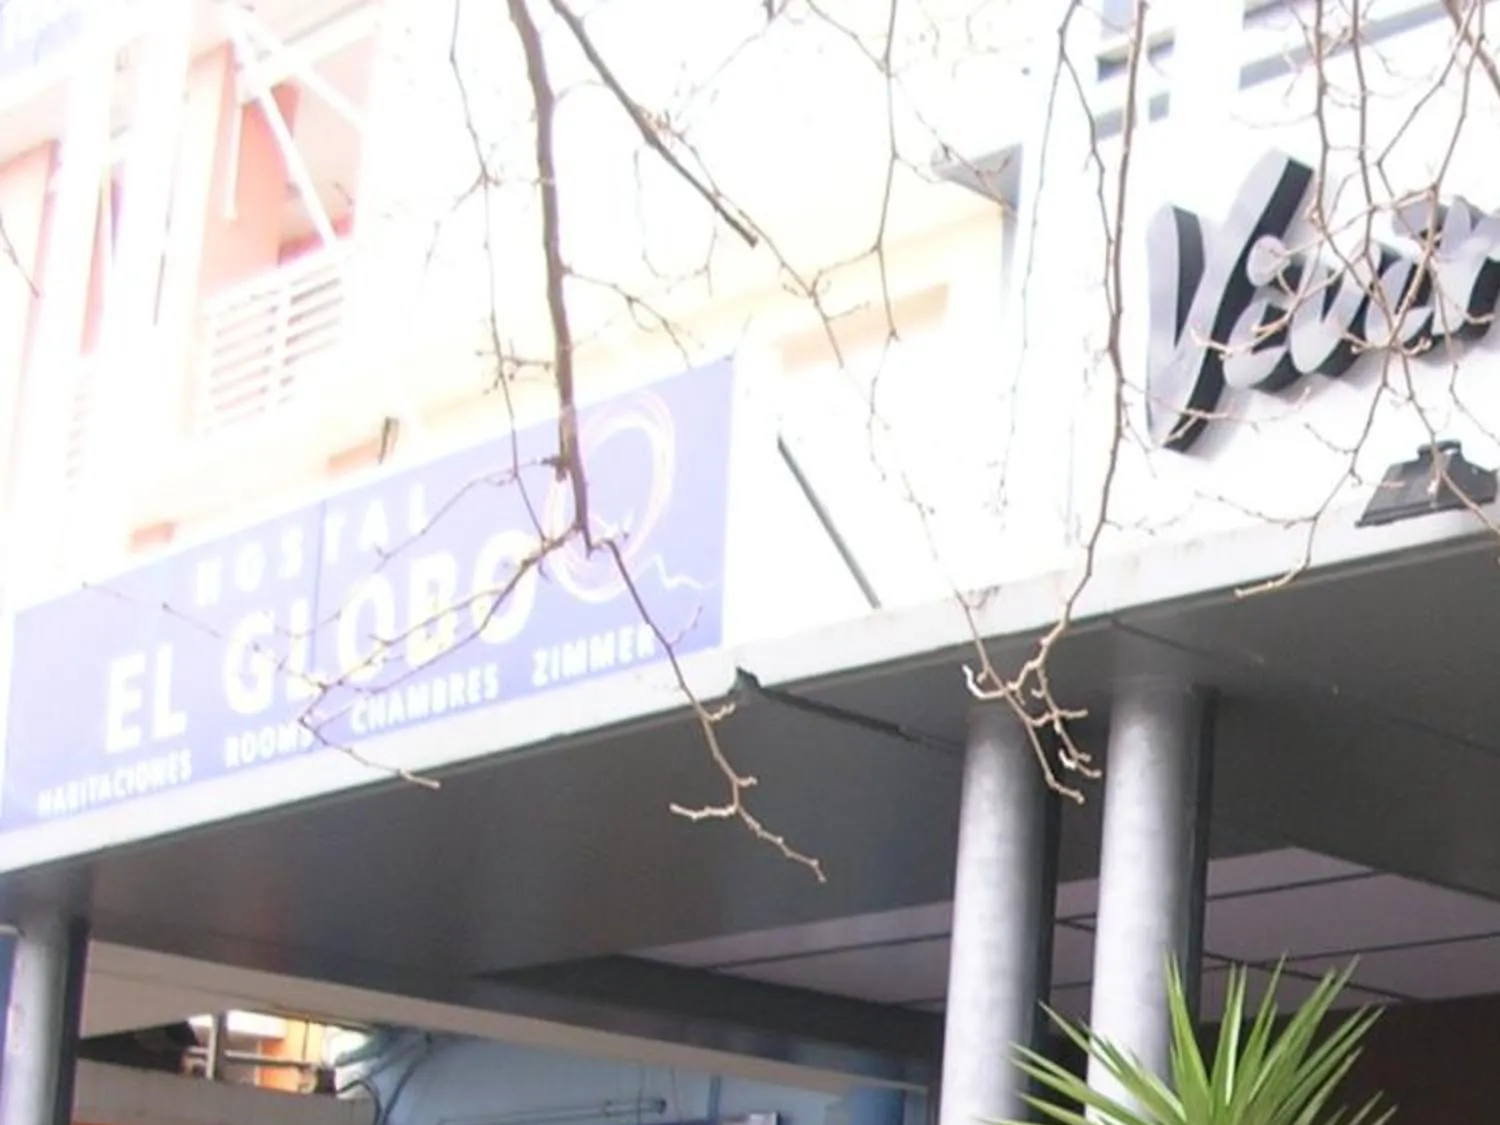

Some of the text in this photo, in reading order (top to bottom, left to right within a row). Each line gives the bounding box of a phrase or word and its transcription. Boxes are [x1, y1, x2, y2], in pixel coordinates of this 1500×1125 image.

[194, 481, 430, 608] HOSTAL
[104, 528, 538, 756] EL GLOBO
[35, 748, 193, 818] HABITACIONES
[223, 716, 314, 769] ROOMS
[350, 662, 499, 736] CHAMBRES
